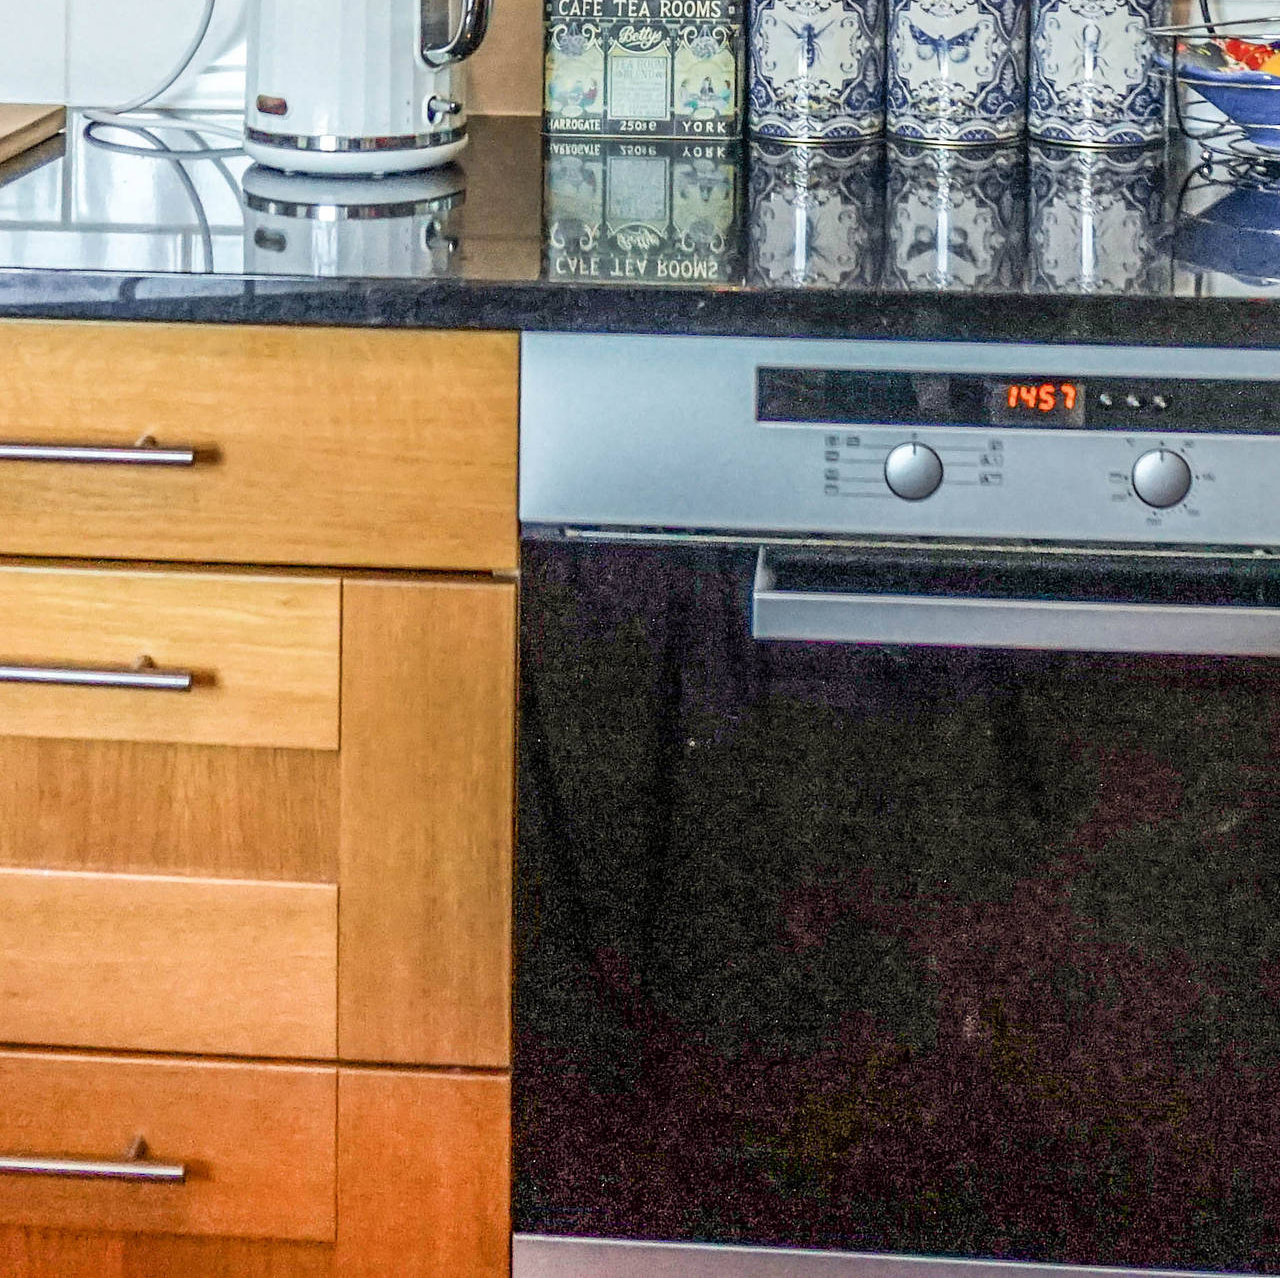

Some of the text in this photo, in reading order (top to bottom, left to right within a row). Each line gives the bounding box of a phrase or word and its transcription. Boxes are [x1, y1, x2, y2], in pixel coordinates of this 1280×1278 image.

[613, 0, 650, 17] TEA
[660, 0, 721, 18] ROOMS
[619, 26, 662, 49] Bettys
[682, 122, 726, 133] YORK
[1008, 383, 1077, 412] 1457
